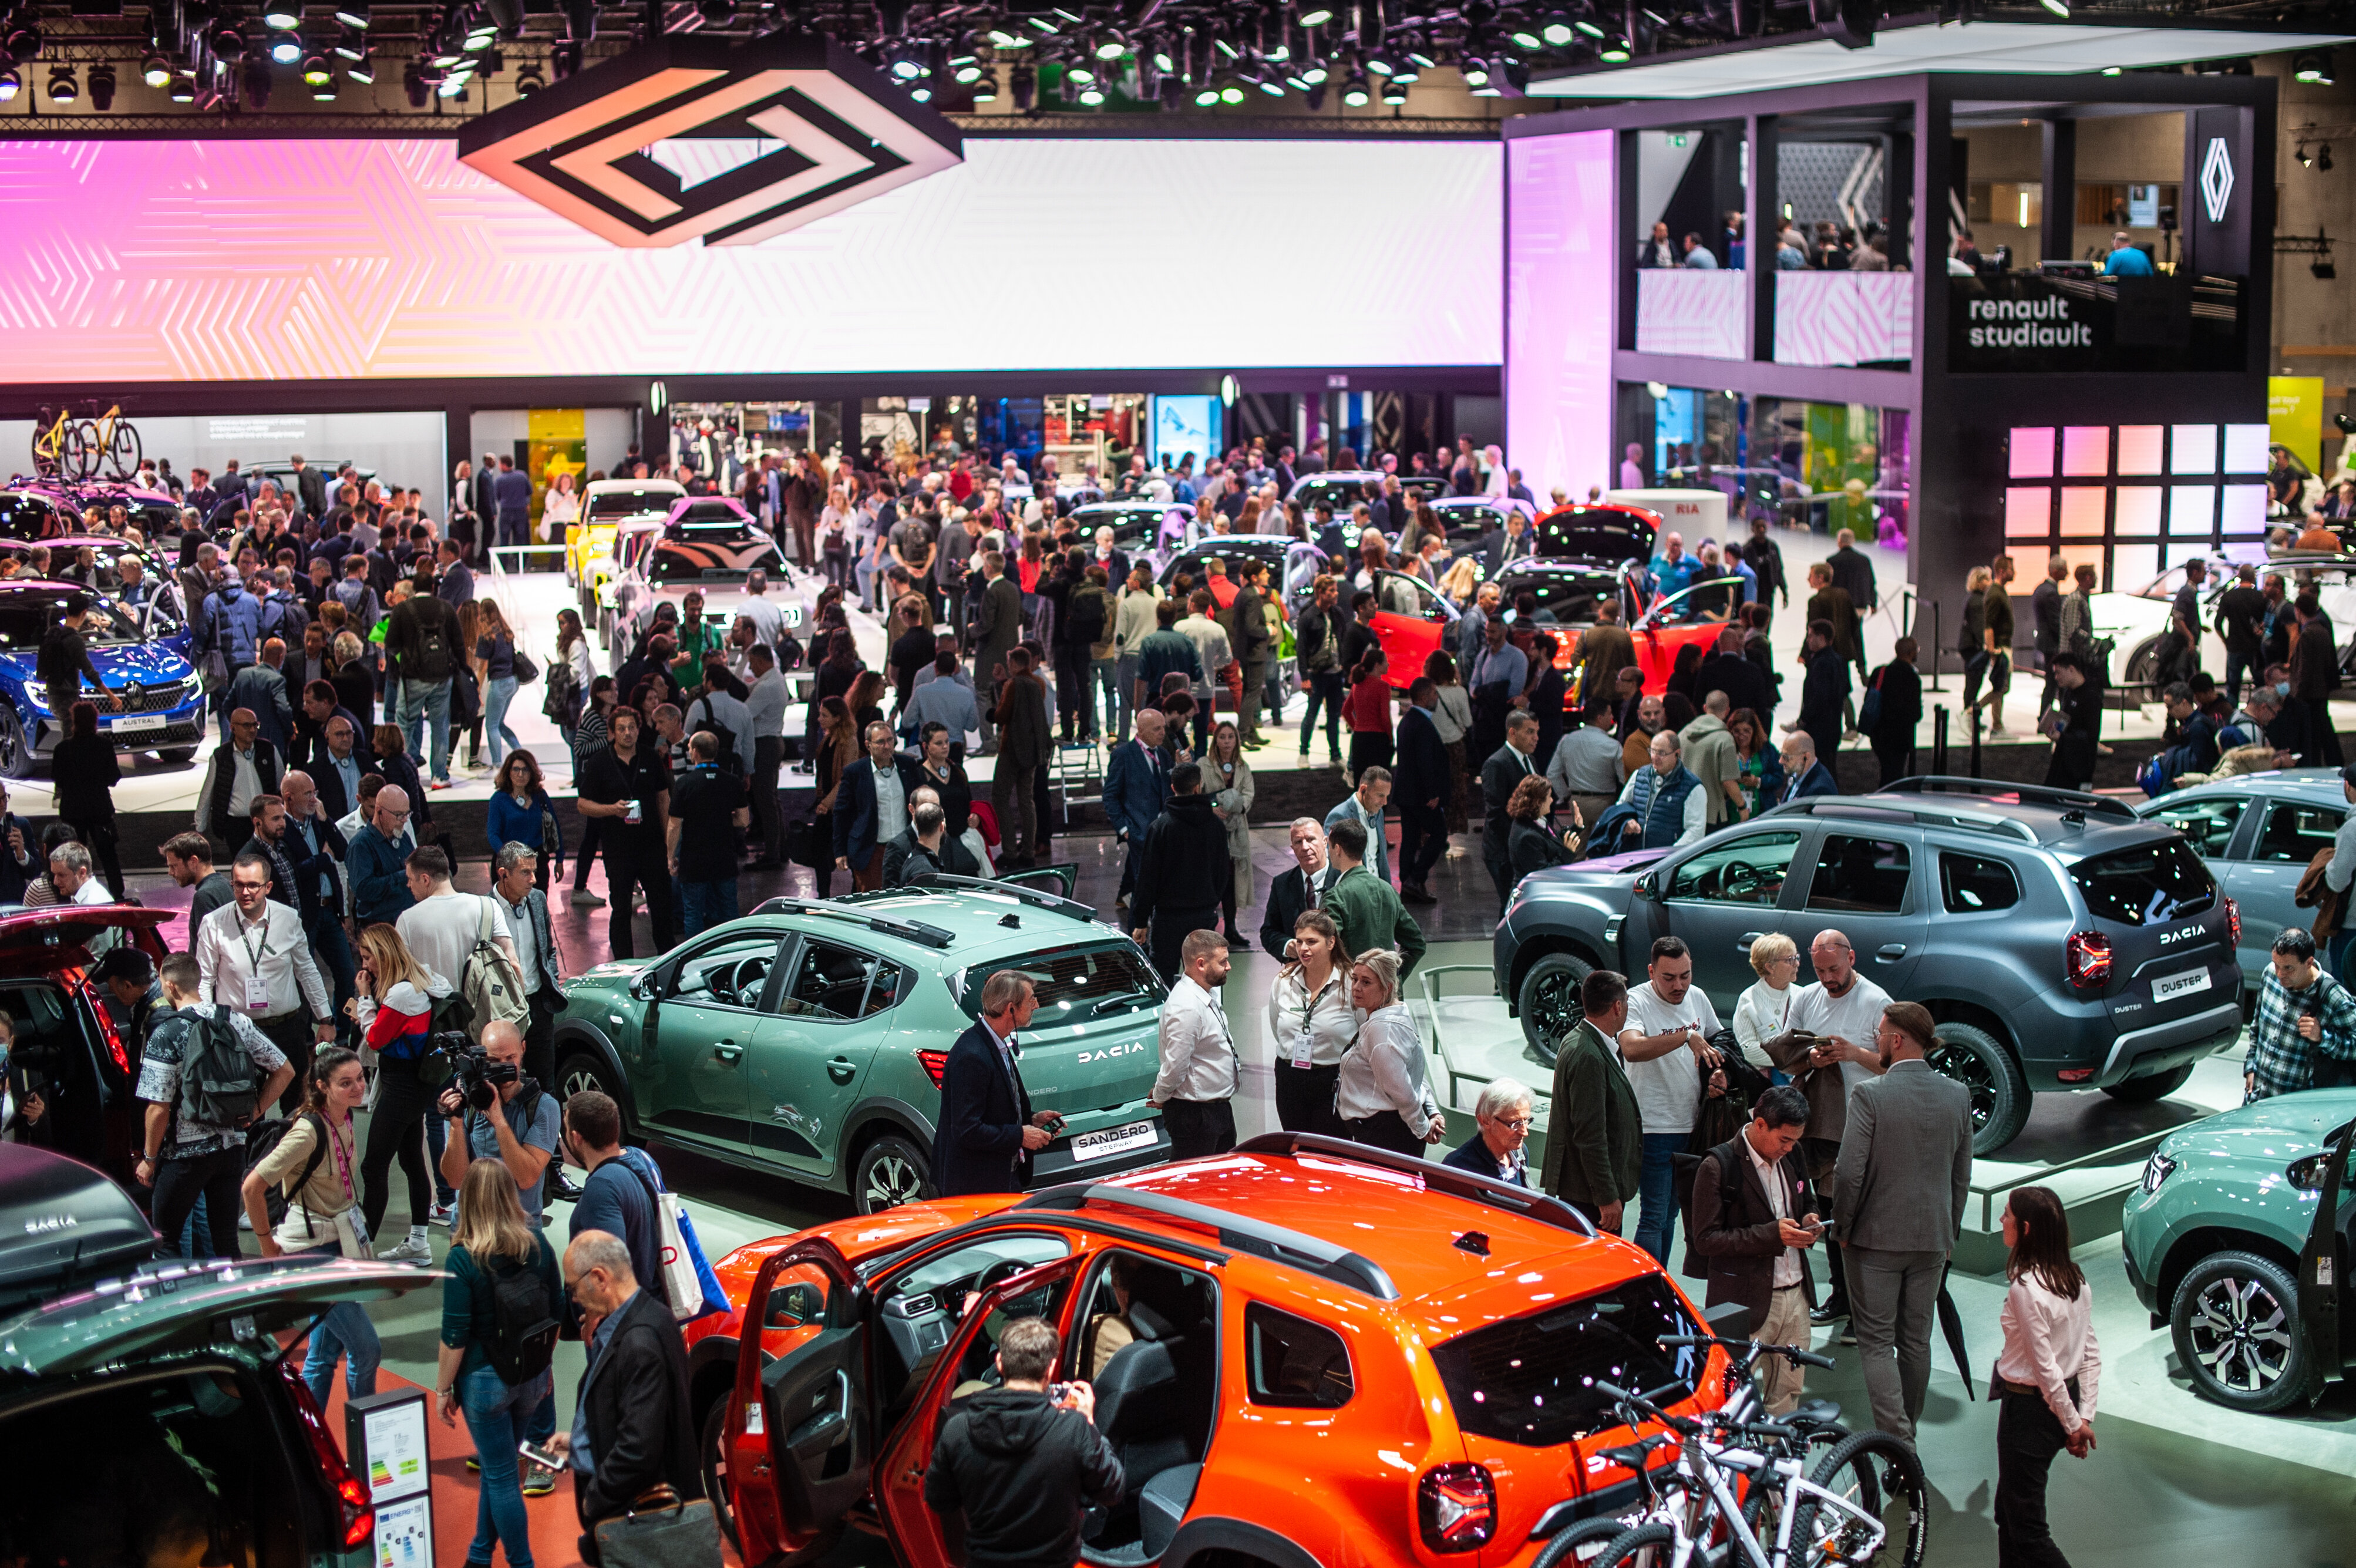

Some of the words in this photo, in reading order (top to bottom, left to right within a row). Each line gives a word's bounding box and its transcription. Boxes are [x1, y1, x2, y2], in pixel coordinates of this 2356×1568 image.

[1969, 294, 2069, 321] renault
[1969, 321, 2092, 348] studiault
[1675, 503, 1700, 514] RIA
[122, 717, 156, 726] AUSTRAL
[2160, 924, 2206, 945] DACIA
[2161, 974, 2202, 994] DUSTER
[2115, 1003, 2142, 1014] DUSTER
[1078, 1041, 1145, 1064] DACIA
[1026, 1086, 1058, 1096] NDERO
[1078, 1124, 1149, 1149] SANDERO
[1099, 1139, 1133, 1152] STEPWAY
[390, 1508, 411, 1520] ENERG
